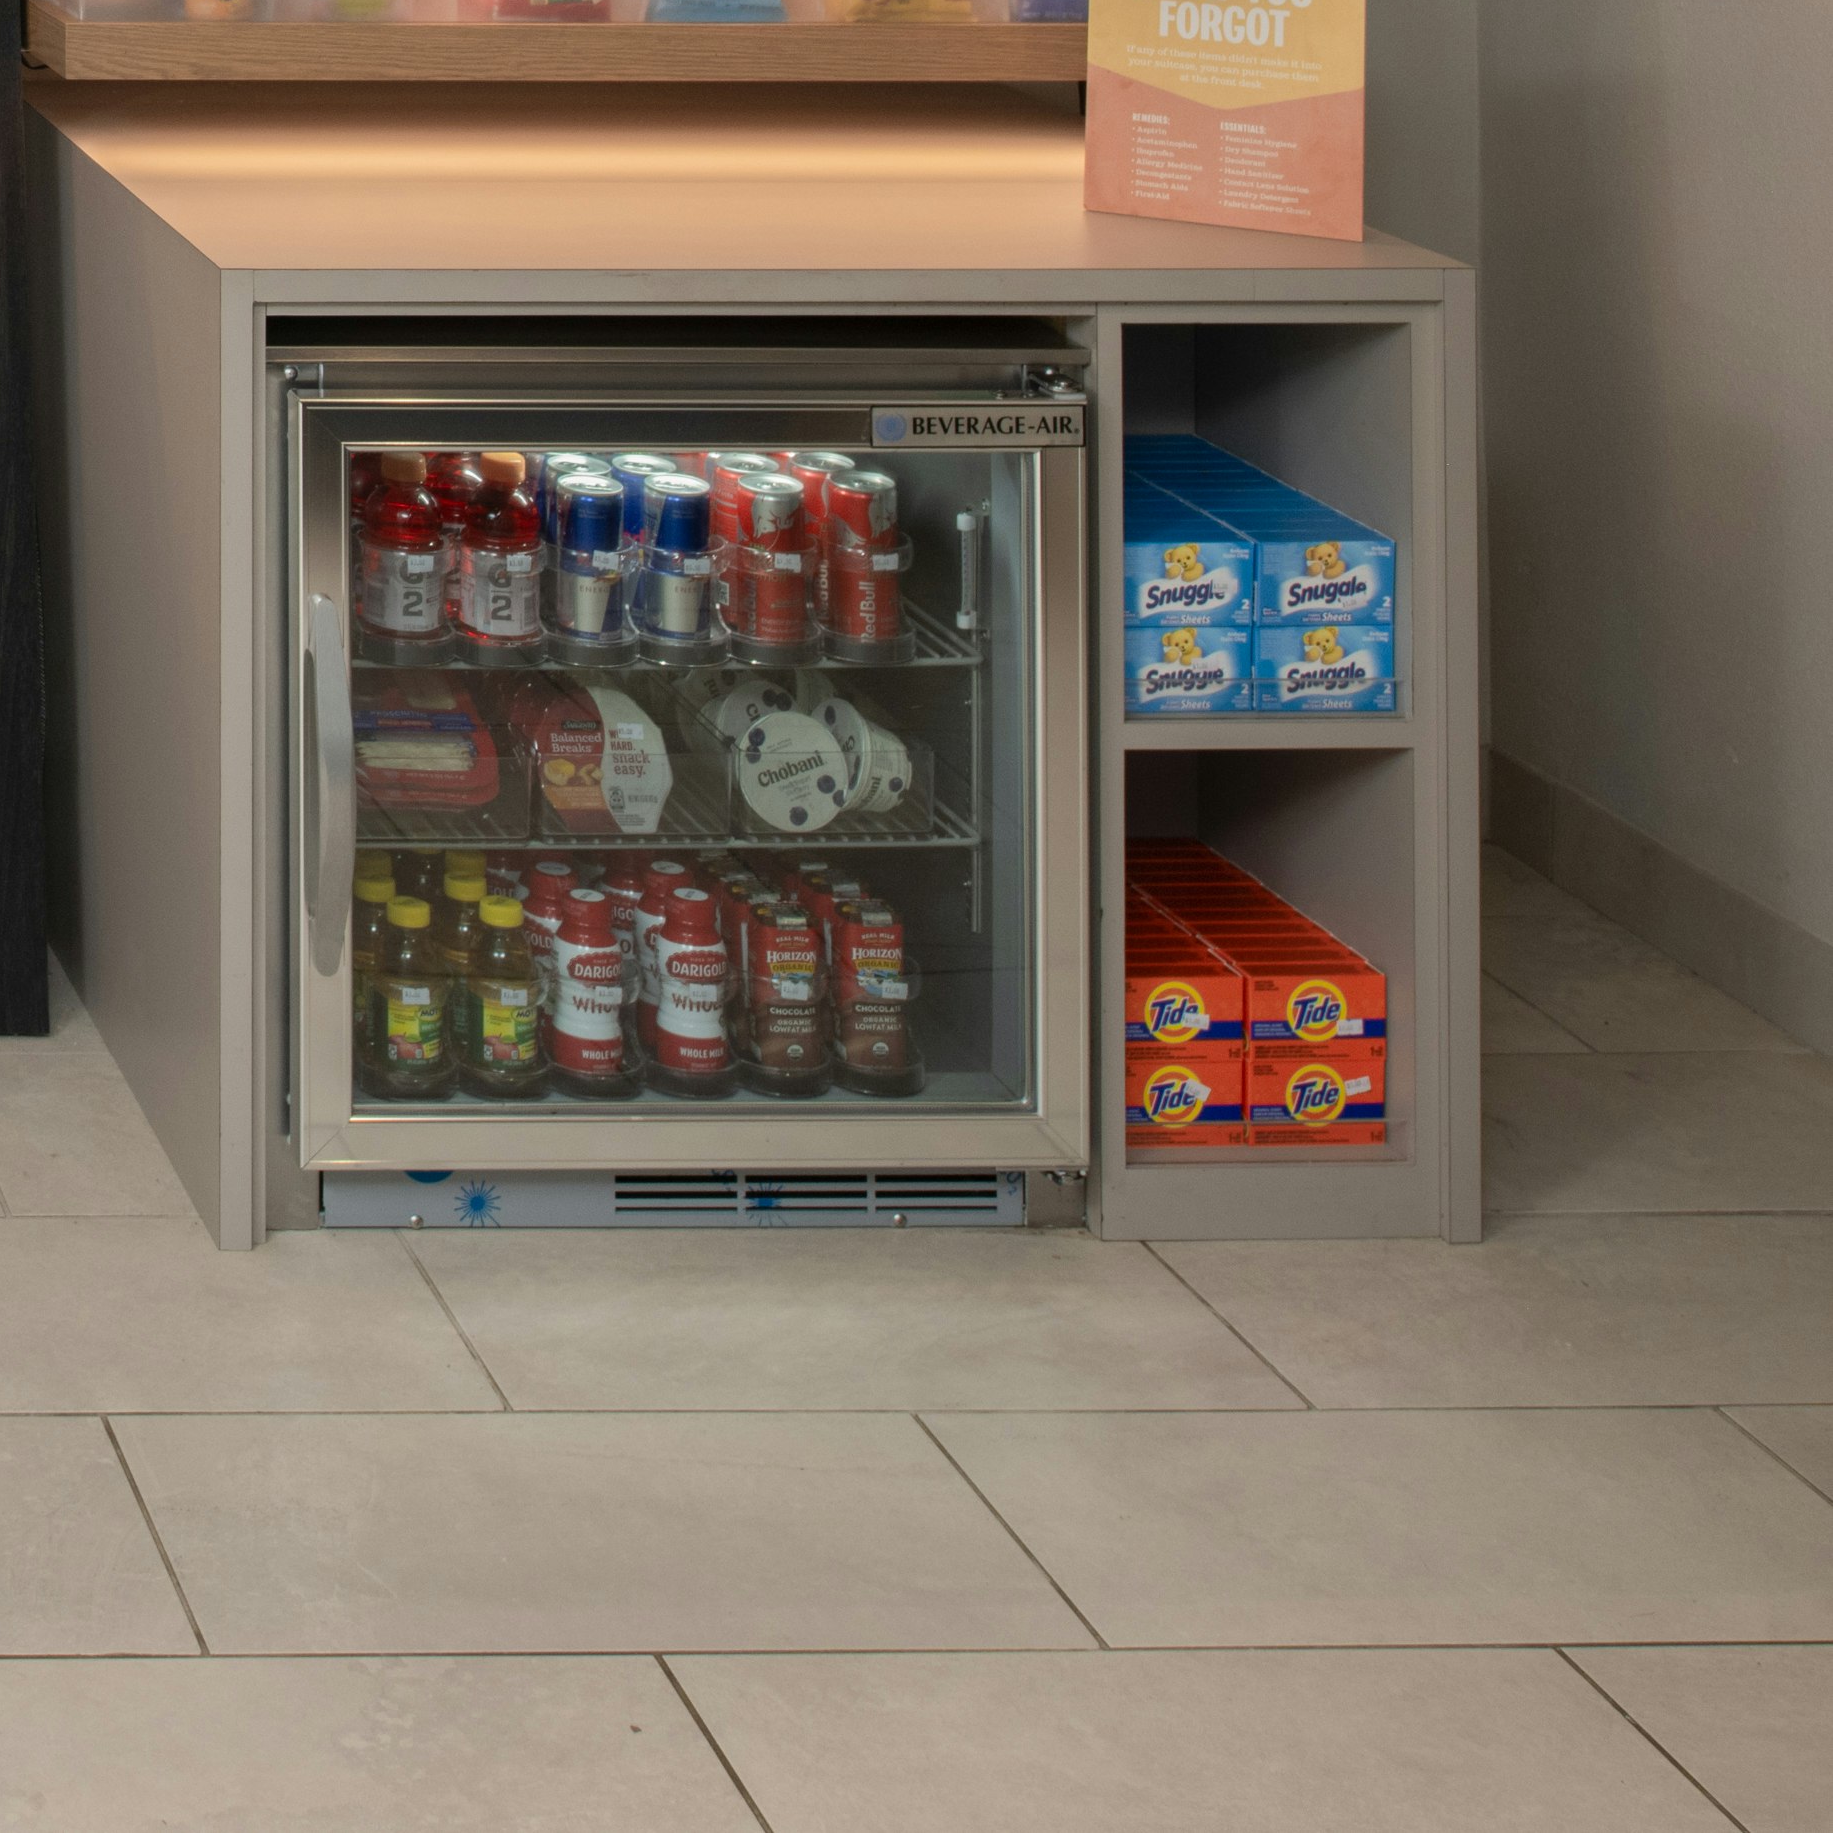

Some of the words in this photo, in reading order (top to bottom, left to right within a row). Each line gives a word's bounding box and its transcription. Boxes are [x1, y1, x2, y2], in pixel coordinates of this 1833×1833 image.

[1159, 0, 1291, 47] FORGOT
[1137, 48, 1155, 56] any
[1170, 50, 1196, 58] these
[1199, 52, 1226, 61] items
[1229, 54, 1259, 64] didn't
[1261, 58, 1288, 67] make
[1301, 61, 1322, 70] into
[1210, 77, 1236, 86] front
[1242, 68, 1289, 79] purchase
[1292, 73, 1319, 82] them
[911, 415, 1077, 437] BEVERAGE-AIR
[1181, 614, 1210, 624] Sheets
[1322, 612, 1351, 622] Sheets
[1287, 662, 1366, 693] Snuggle
[1181, 699, 1210, 709] Sheets
[1323, 698, 1352, 709] Sheets
[550, 733, 602, 743] Balanced
[552, 742, 592, 753] Breaks
[613, 752, 651, 764] snack
[757, 751, 825, 788] Chobani
[766, 950, 816, 963] HORIZON
[852, 948, 902, 961] HORIZON
[1292, 996, 1341, 1033] Tide
[680, 1048, 704, 1059] WHOLE
[1292, 1080, 1340, 1116] Tide
